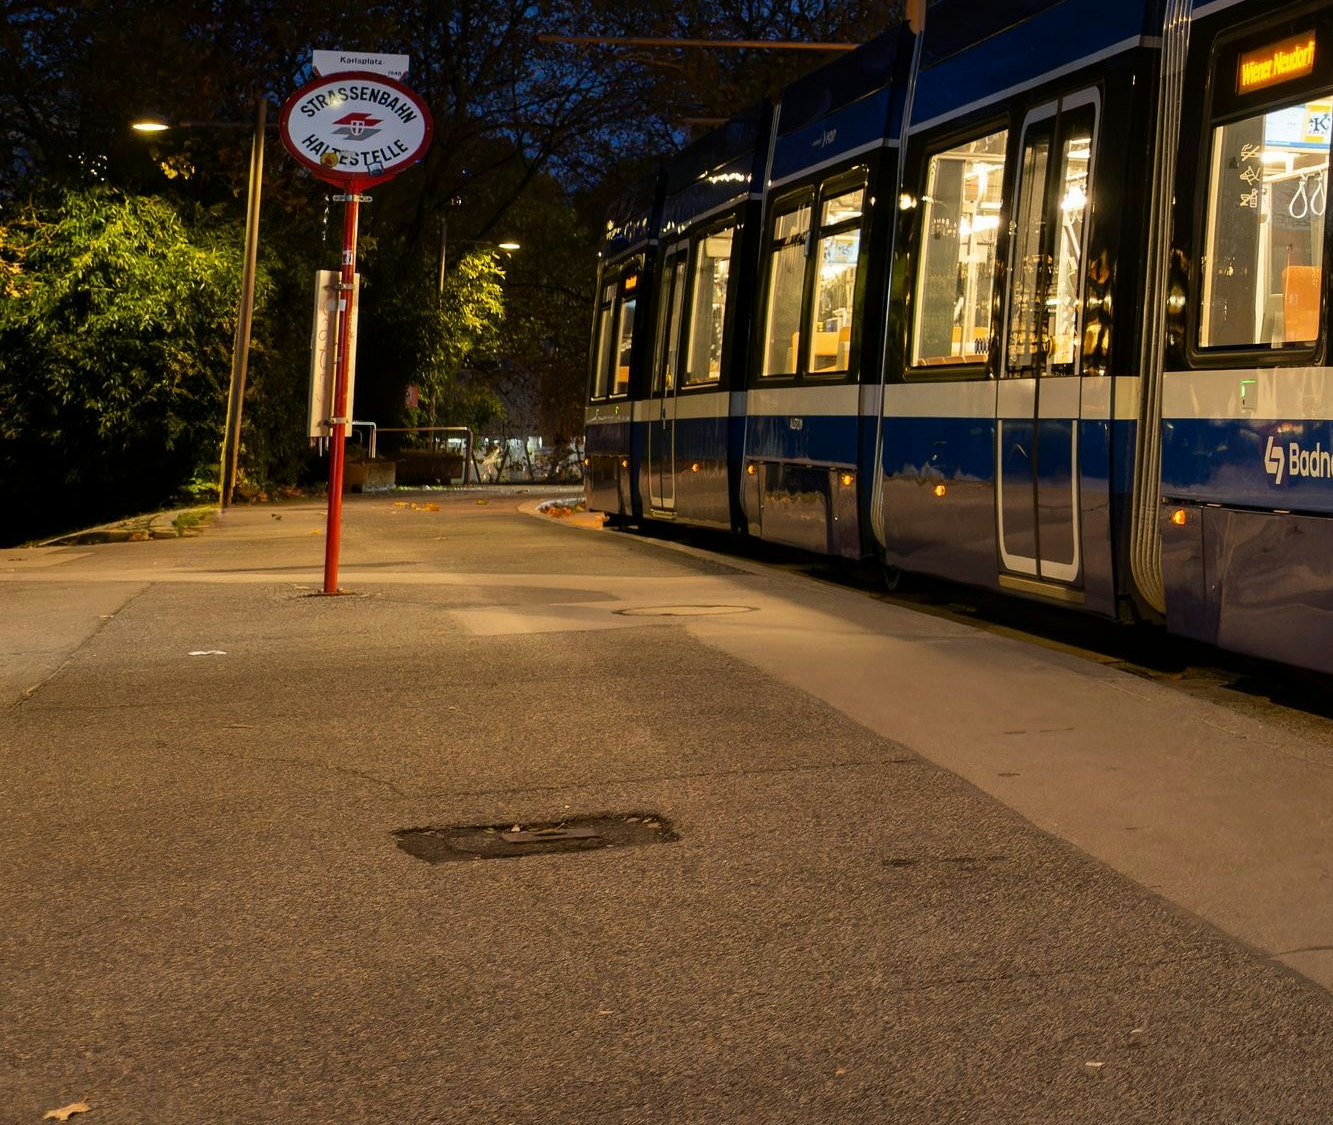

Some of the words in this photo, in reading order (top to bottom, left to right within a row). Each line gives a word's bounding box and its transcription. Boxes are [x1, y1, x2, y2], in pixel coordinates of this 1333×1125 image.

[340, 56, 383, 65] Karlsplatz
[1242, 60, 1273, 86] Wiener
[1273, 41, 1315, 75] Neudorf
[300, 86, 417, 124] STRASSENBAHN
